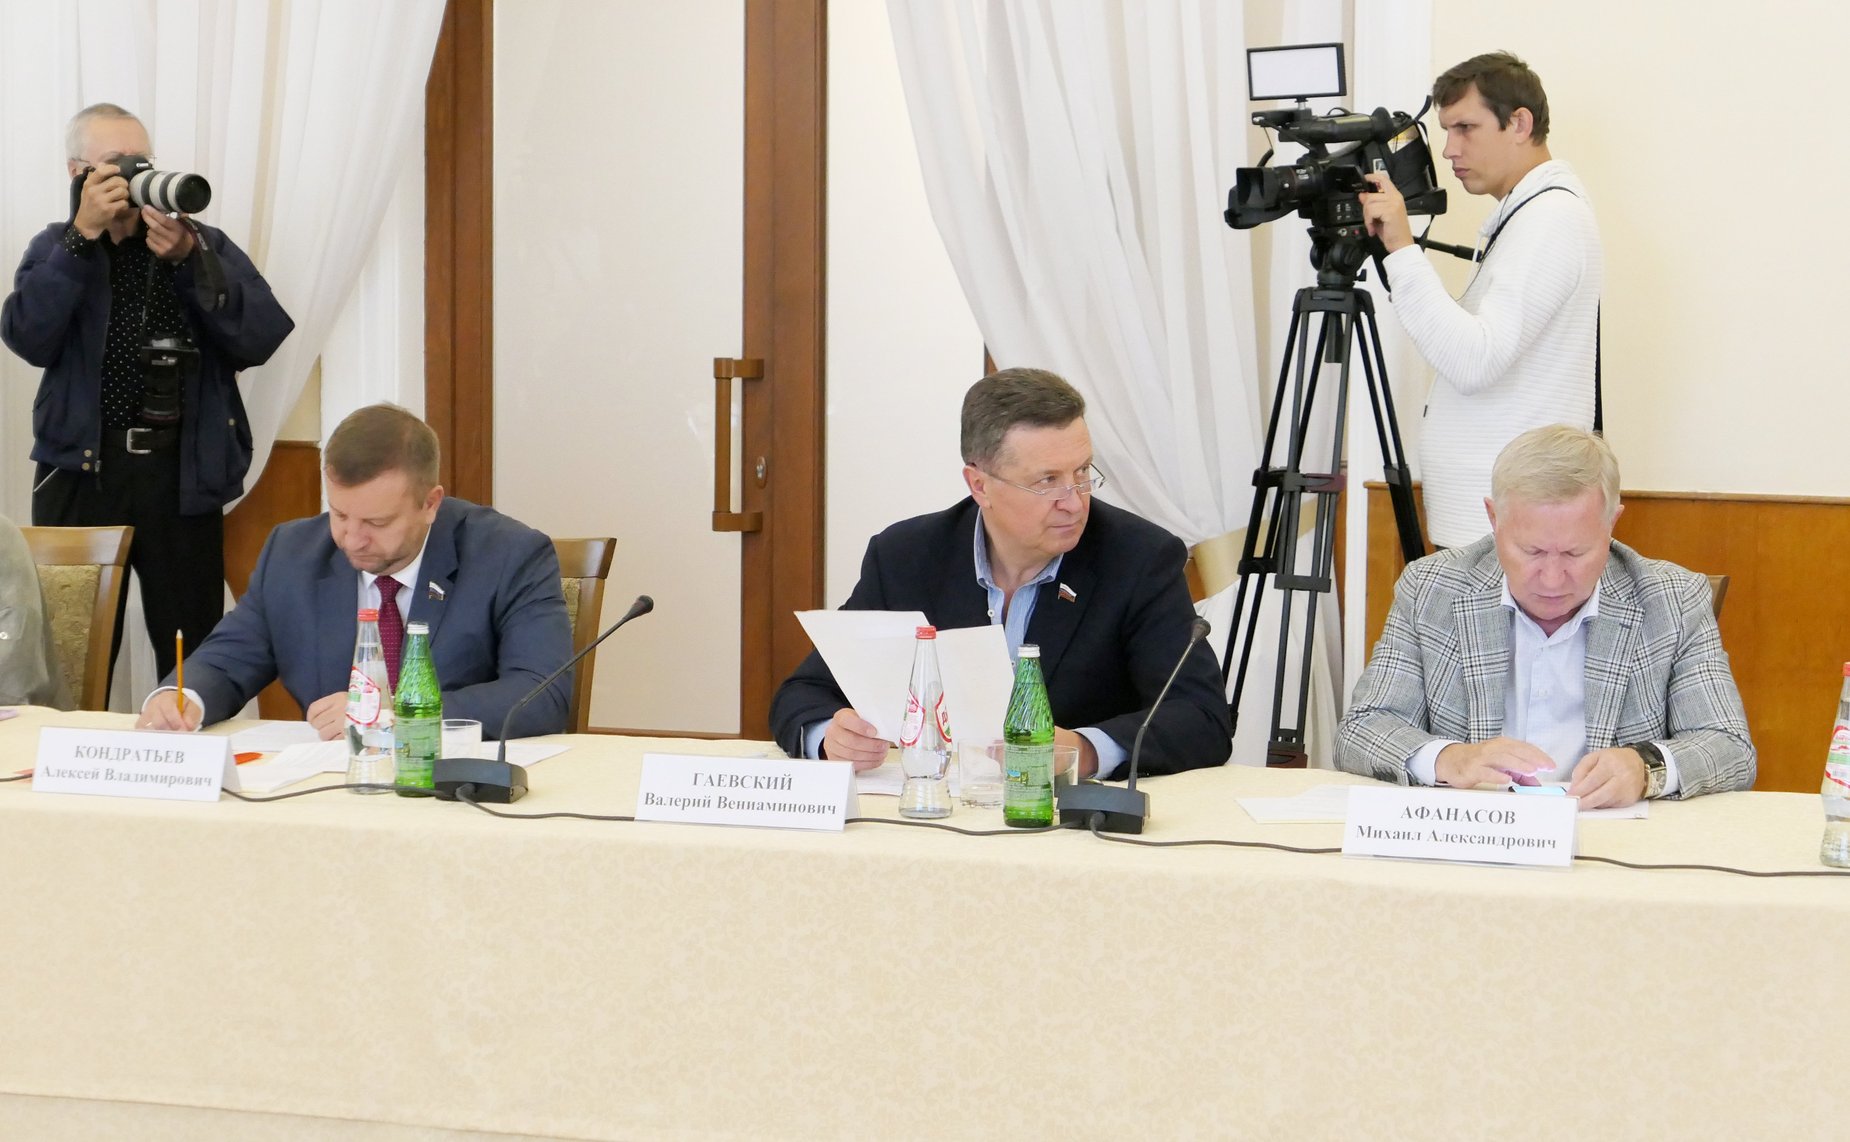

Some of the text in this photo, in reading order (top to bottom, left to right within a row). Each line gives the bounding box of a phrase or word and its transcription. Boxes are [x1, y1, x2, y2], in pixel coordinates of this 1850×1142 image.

[74, 745, 185, 763] КОНДРАТЬЕВ
[40, 765, 213, 788] Алексей Владимирович
[692, 772, 793, 791] ГАЕВСКИЙ
[644, 792, 836, 815] Валерий Вениаминович
[1400, 806, 1516, 824] АФАНАСОВ
[1356, 825, 1557, 849] Михаил Александрович
